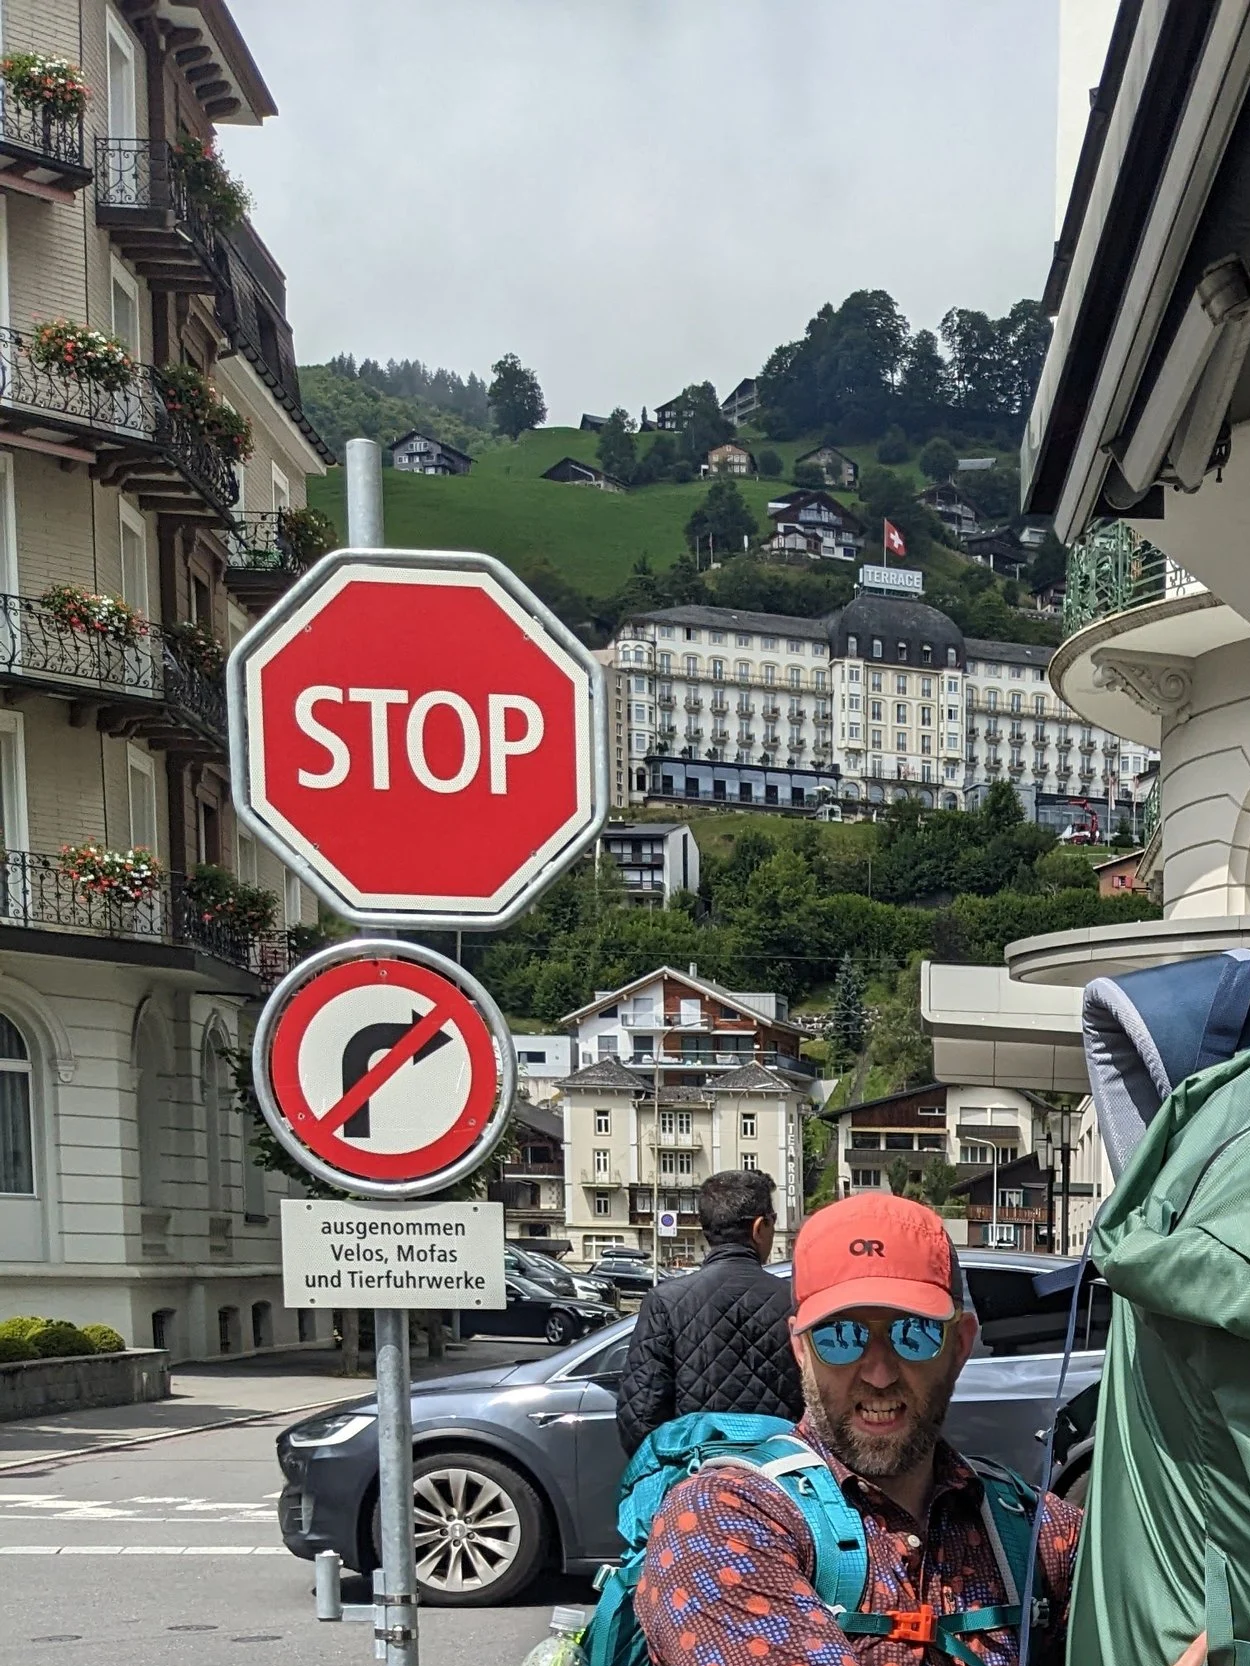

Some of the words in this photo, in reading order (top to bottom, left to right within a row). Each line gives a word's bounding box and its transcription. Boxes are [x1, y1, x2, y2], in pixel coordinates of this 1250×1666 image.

[866, 569, 921, 588] TERRACE
[295, 684, 545, 795] STOP
[787, 1123, 796, 1157] TEA
[787, 1163, 796, 1207] ROOM
[321, 1218, 466, 1239] ausgenommen
[331, 1243, 389, 1265] Velos,
[396, 1243, 457, 1263] Mofas
[849, 1238, 885, 1257] OR
[305, 1270, 341, 1288] und
[347, 1269, 485, 1289] Tierfuhrwerke
